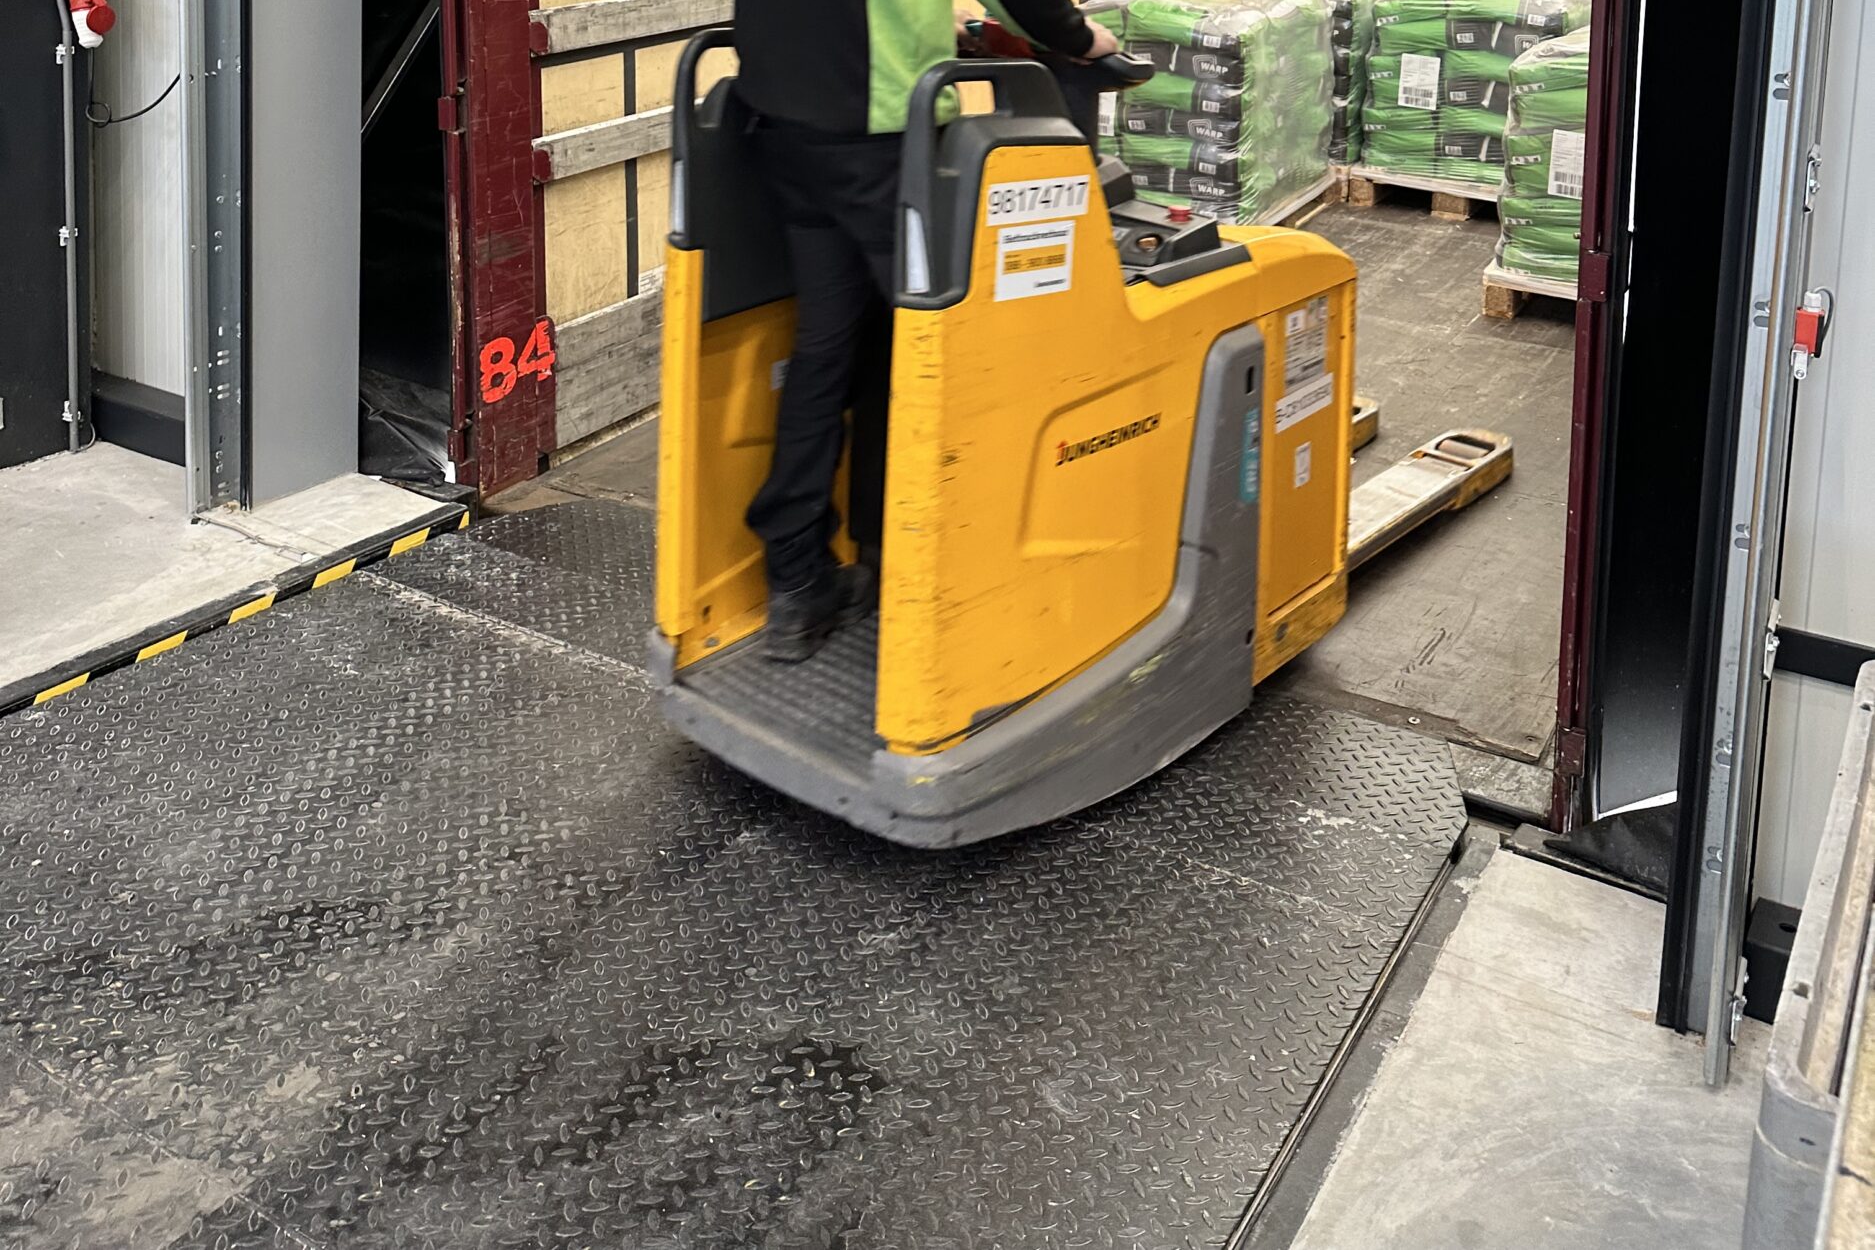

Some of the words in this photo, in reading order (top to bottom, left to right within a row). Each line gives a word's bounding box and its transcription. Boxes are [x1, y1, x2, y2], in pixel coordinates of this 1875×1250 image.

[1200, 61, 1229, 74] WARP
[1195, 126, 1223, 139] WARP
[988, 181, 1090, 215] 98174717
[1197, 183, 1226, 196] WARP
[479, 319, 556, 404] 84
[1055, 411, 1163, 467] JUNGHEINRICH
